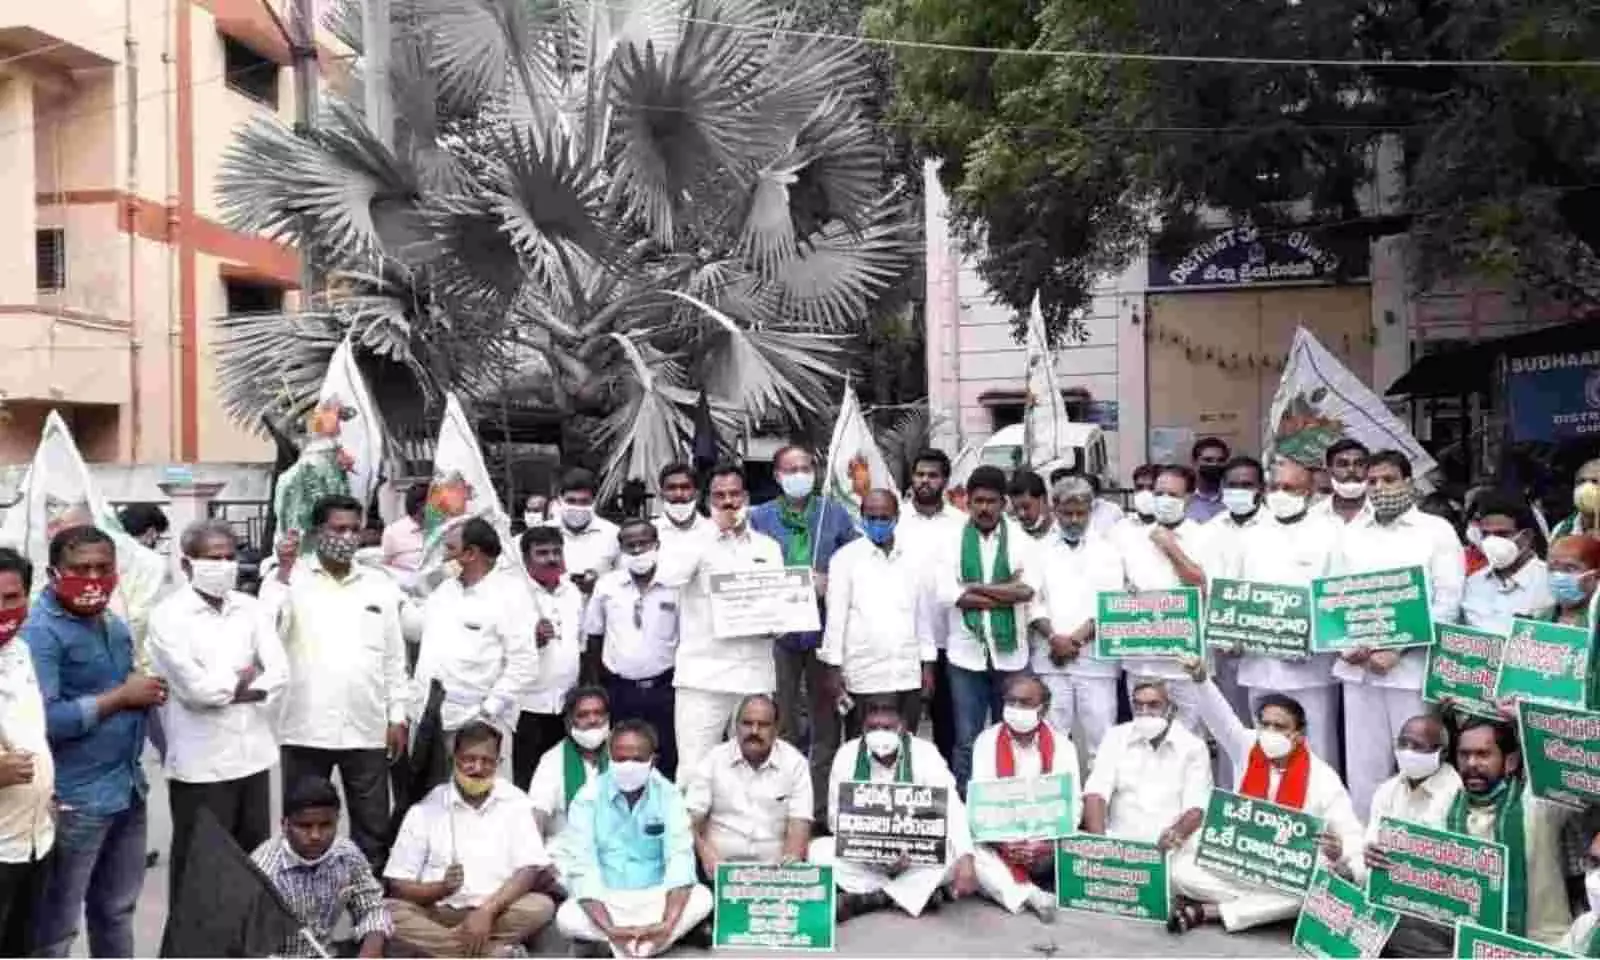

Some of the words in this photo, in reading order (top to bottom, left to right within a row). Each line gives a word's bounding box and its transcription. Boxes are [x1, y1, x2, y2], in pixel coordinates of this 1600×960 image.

[1169, 228, 1236, 284] DISTRICT
[1222, 800, 1253, 822] ఒకే
[1253, 810, 1307, 846] రాష్ట్రం
[1204, 826, 1236, 848] ఒకే
[1235, 836, 1313, 871] రాజధాని
